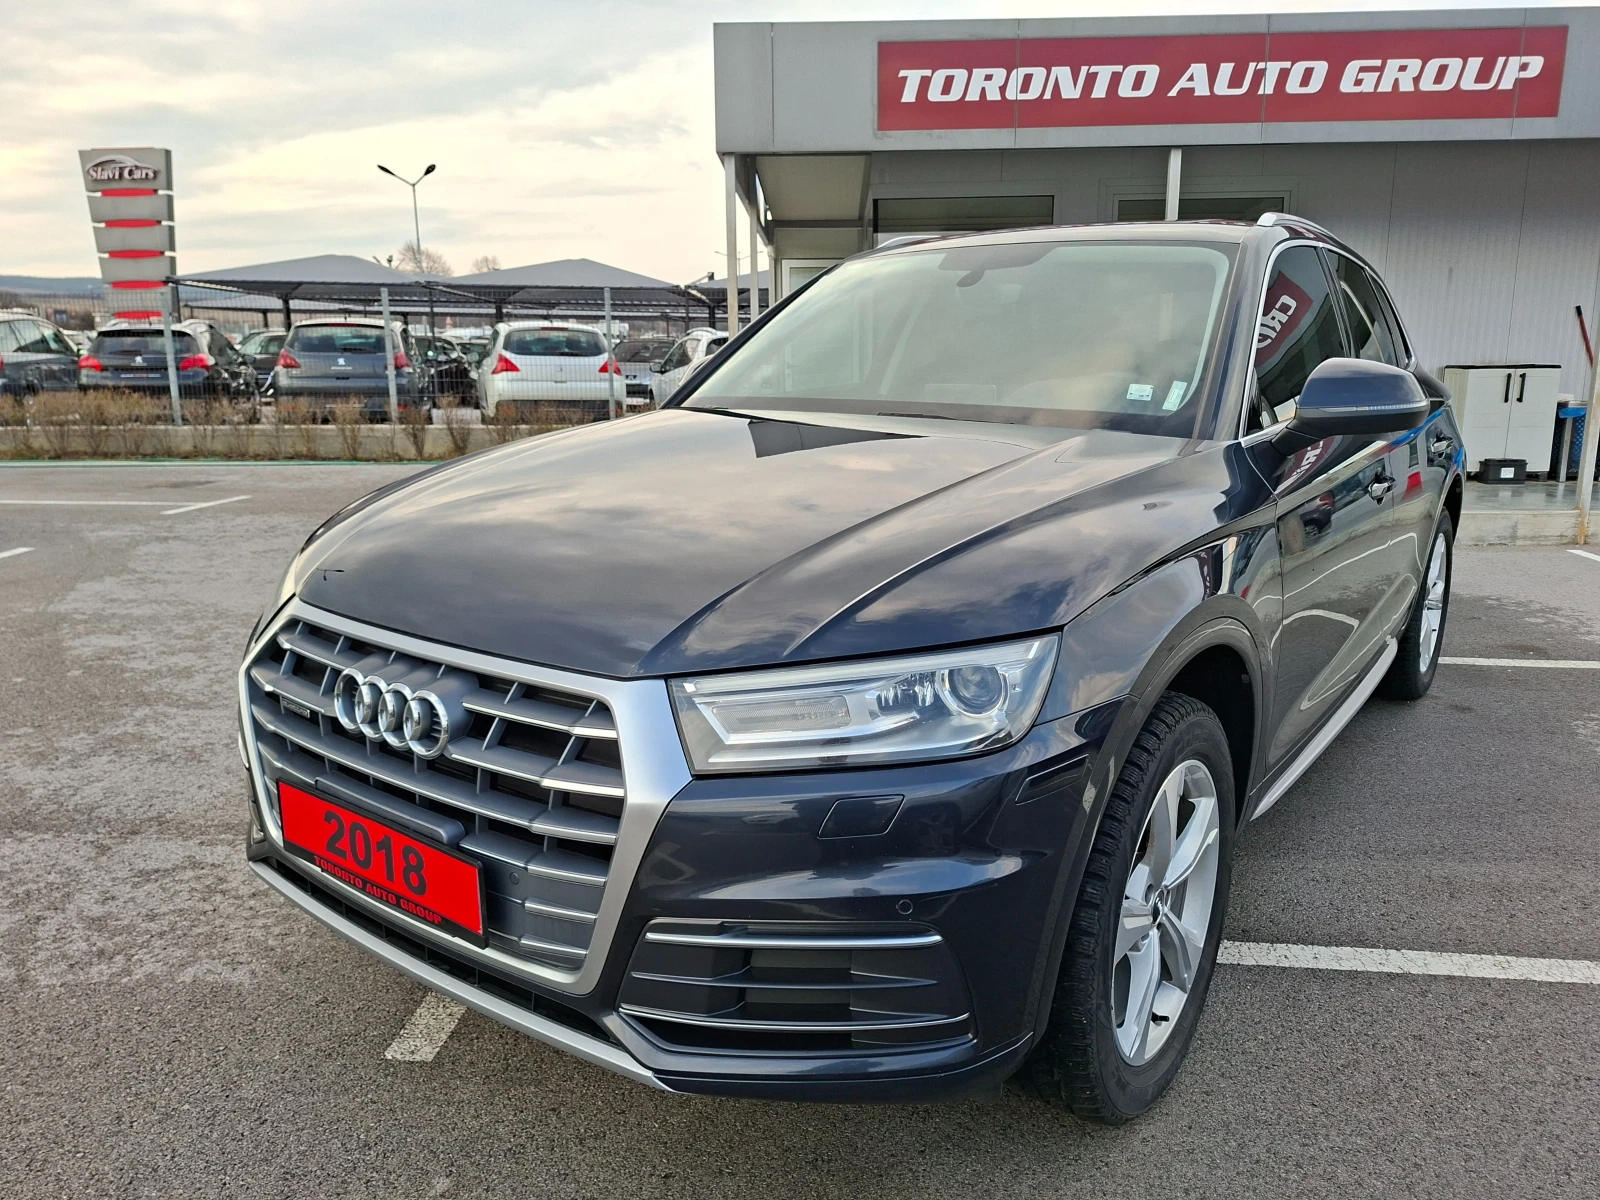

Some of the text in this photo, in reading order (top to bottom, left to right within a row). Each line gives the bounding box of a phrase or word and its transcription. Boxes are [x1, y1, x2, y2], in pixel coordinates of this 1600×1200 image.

[898, 55, 1544, 103] TORONTO AUTO GROUP
[88, 166, 155, 181] Slavi Cars
[324, 811, 427, 896] 2018
[314, 855, 443, 924] TORONTO AUTO GROUP
